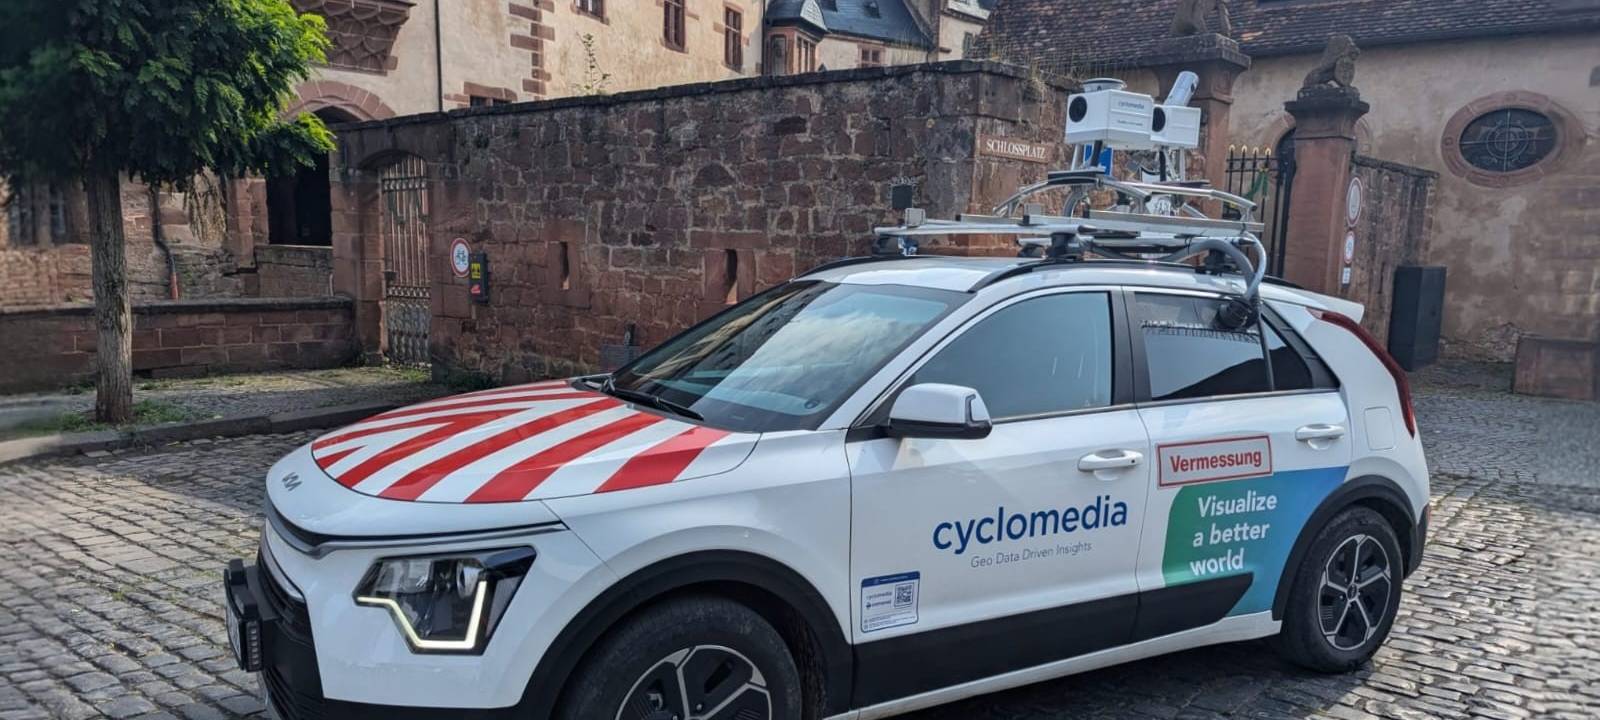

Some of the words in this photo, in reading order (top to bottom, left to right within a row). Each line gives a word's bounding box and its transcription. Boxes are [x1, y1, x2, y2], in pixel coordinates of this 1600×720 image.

[985, 138, 1046, 159] SCHLOSSPLATZ
[1169, 450, 1262, 473] Vermessung
[1198, 489, 1278, 518] Visualize
[932, 495, 1128, 555] cyclomedia
[1192, 531, 1204, 548] a
[1209, 522, 1270, 545] better
[970, 555, 993, 568] Geo
[995, 552, 1020, 565] Data
[1022, 547, 1053, 561] Driven
[1056, 541, 1092, 556] Insights
[1189, 547, 1245, 576] world
